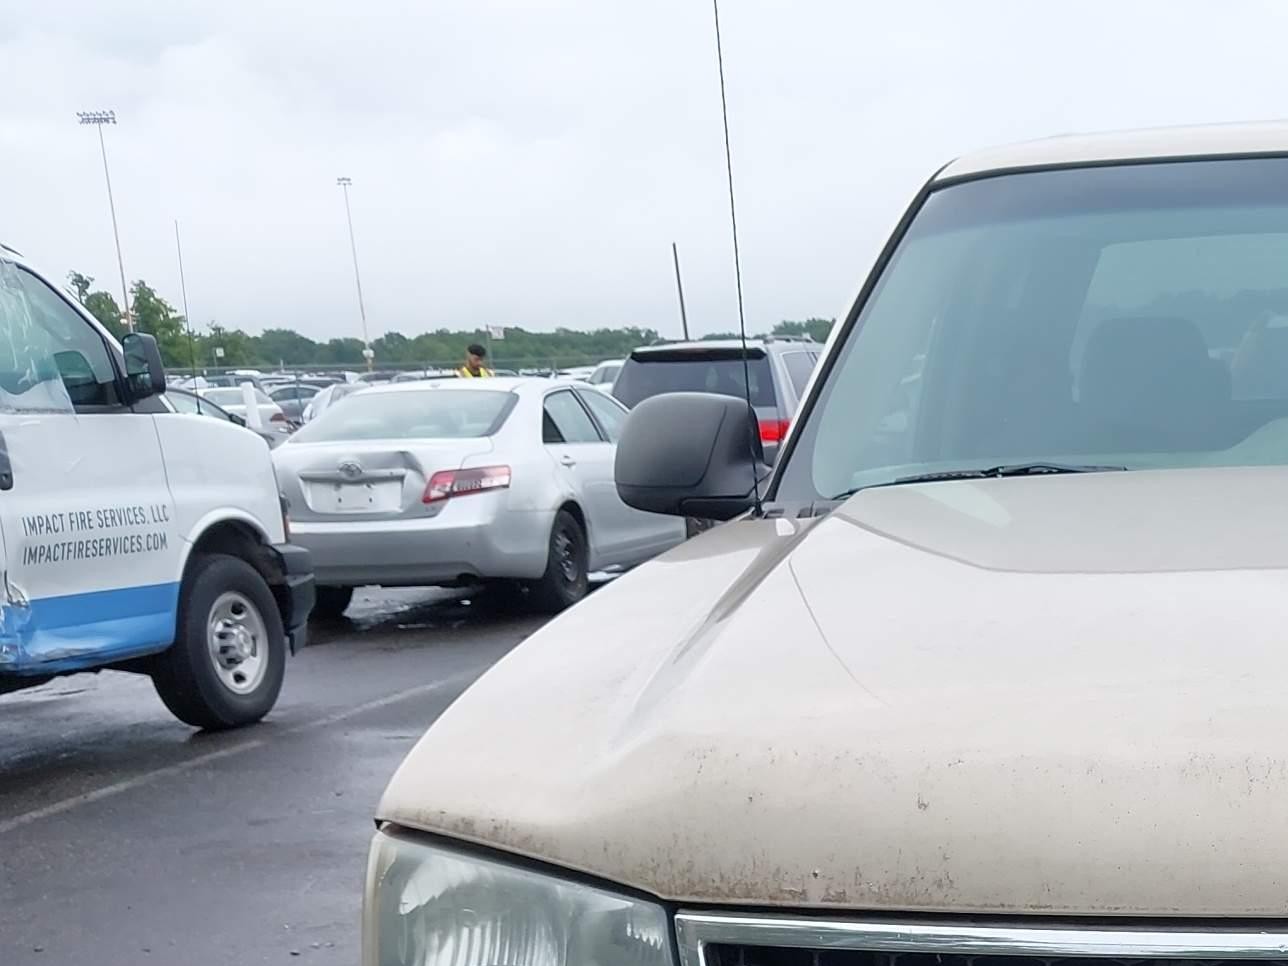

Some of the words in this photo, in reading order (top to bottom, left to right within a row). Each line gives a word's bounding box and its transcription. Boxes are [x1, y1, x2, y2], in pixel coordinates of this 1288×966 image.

[22, 513, 65, 537] IMPACT
[68, 510, 94, 532] FIRE
[150, 504, 169, 523] LLC
[23, 532, 168, 566] IMPACTFIRESERVICES.COM
